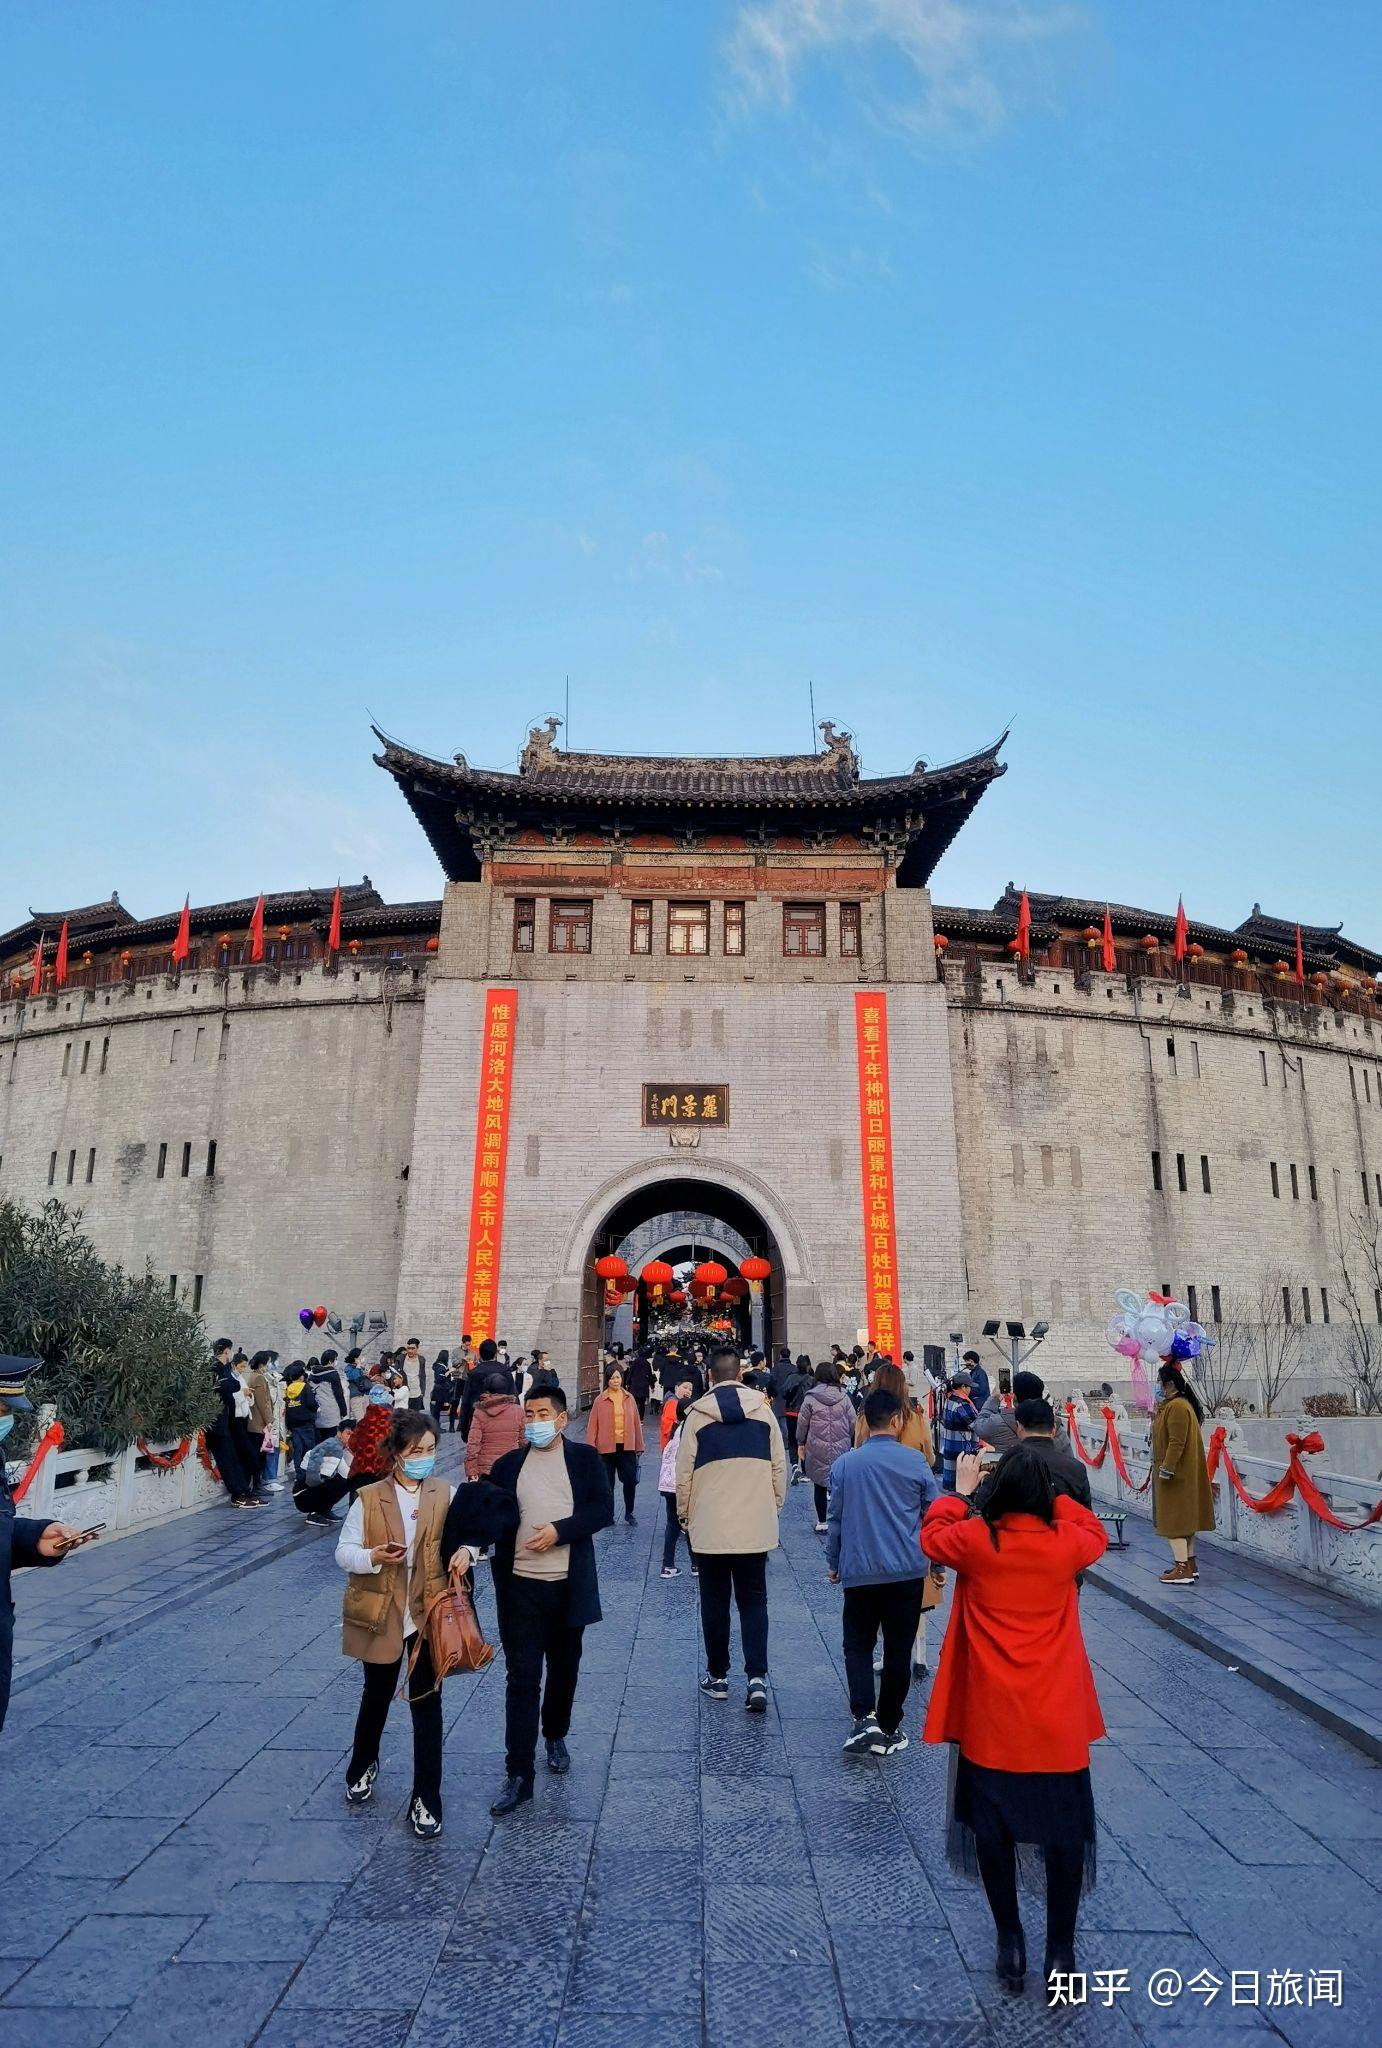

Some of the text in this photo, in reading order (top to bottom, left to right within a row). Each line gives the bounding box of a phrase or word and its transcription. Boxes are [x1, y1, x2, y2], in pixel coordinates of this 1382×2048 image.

[862, 1006, 896, 1352] 喜看千年神都日丽景和古城百姓如意吉祥
